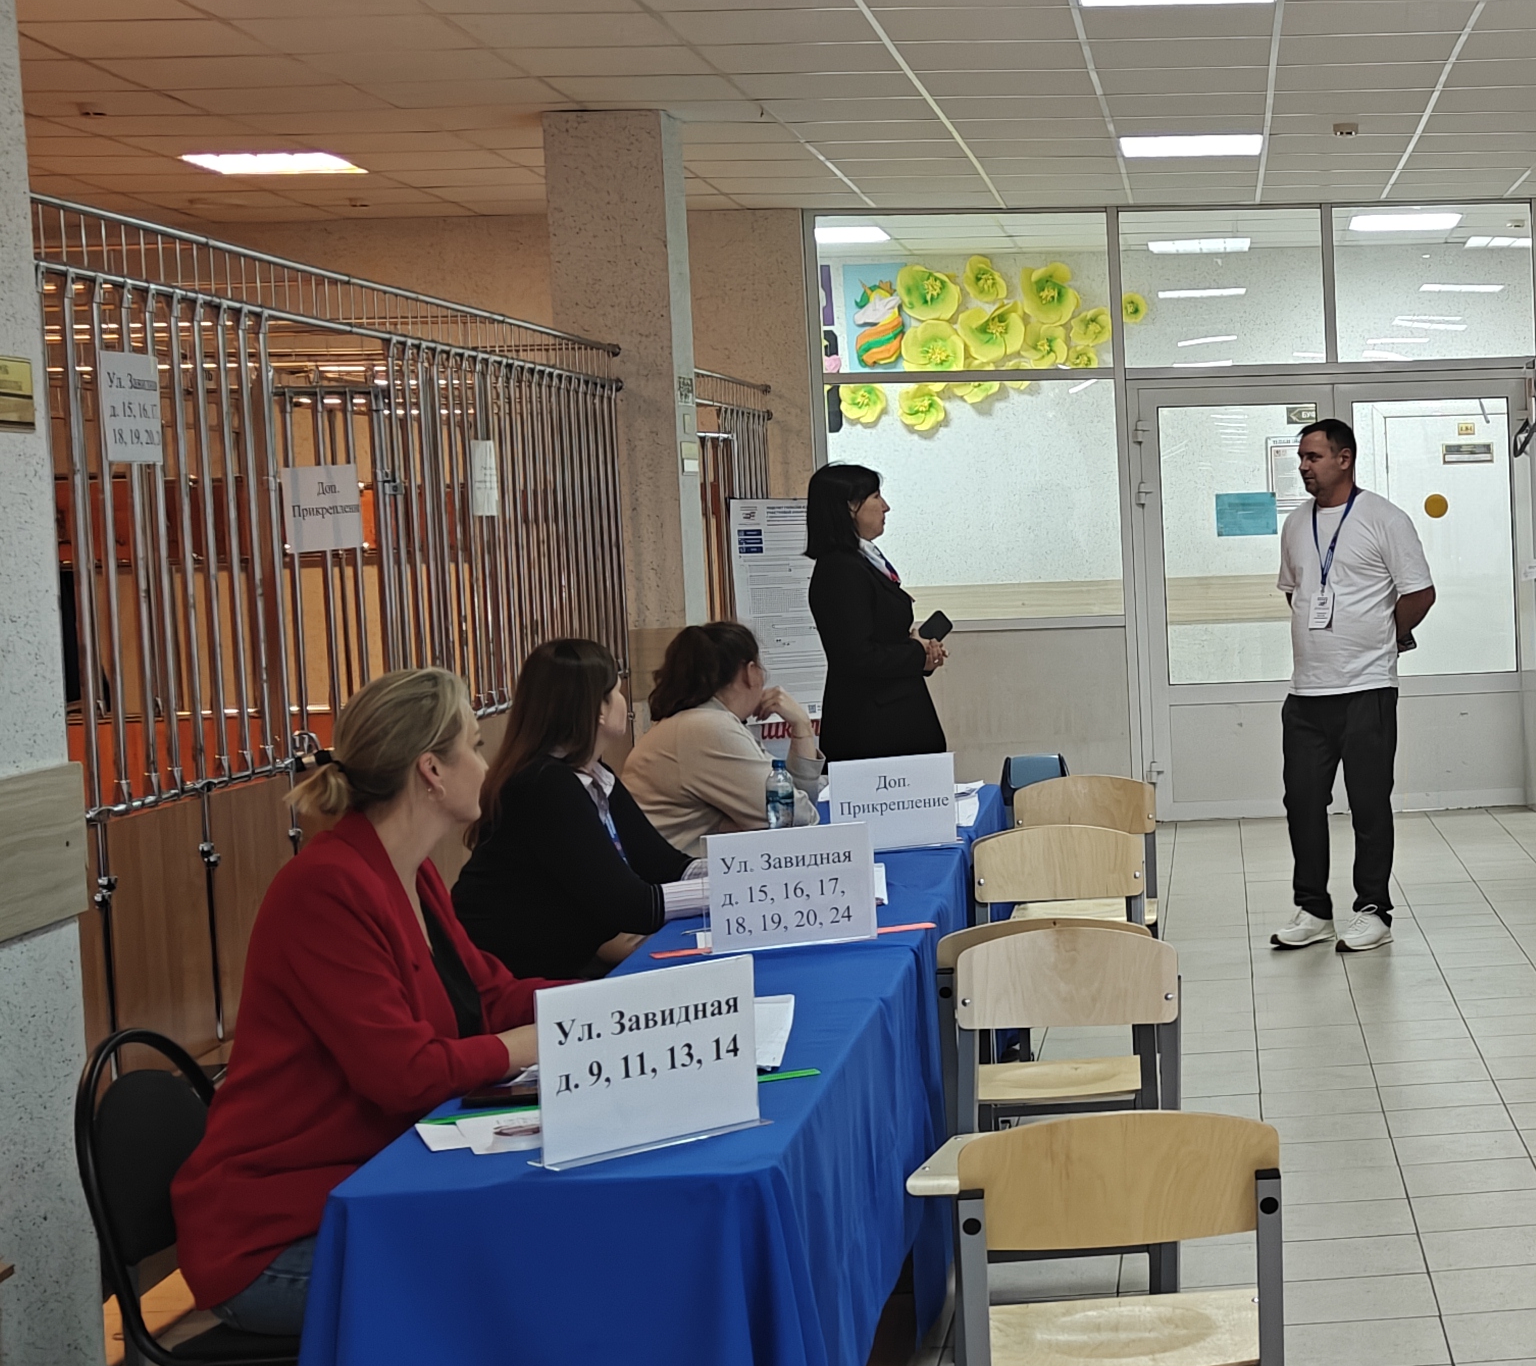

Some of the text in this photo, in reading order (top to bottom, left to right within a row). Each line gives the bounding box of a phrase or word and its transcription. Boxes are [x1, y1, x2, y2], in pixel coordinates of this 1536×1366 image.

[317, 481, 340, 496] Доп.
[876, 775, 910, 792] Доп.
[839, 796, 950, 818] Прикрепление
[720, 849, 852, 875] Ул. Завидная
[721, 877, 846, 907] д. 15, 16, 17,
[726, 905, 853, 936] 18, 19, 20, 24
[554, 996, 739, 1046] Ул. Завидная
[556, 1033, 739, 1096] д. 9, 11, 13, 14
